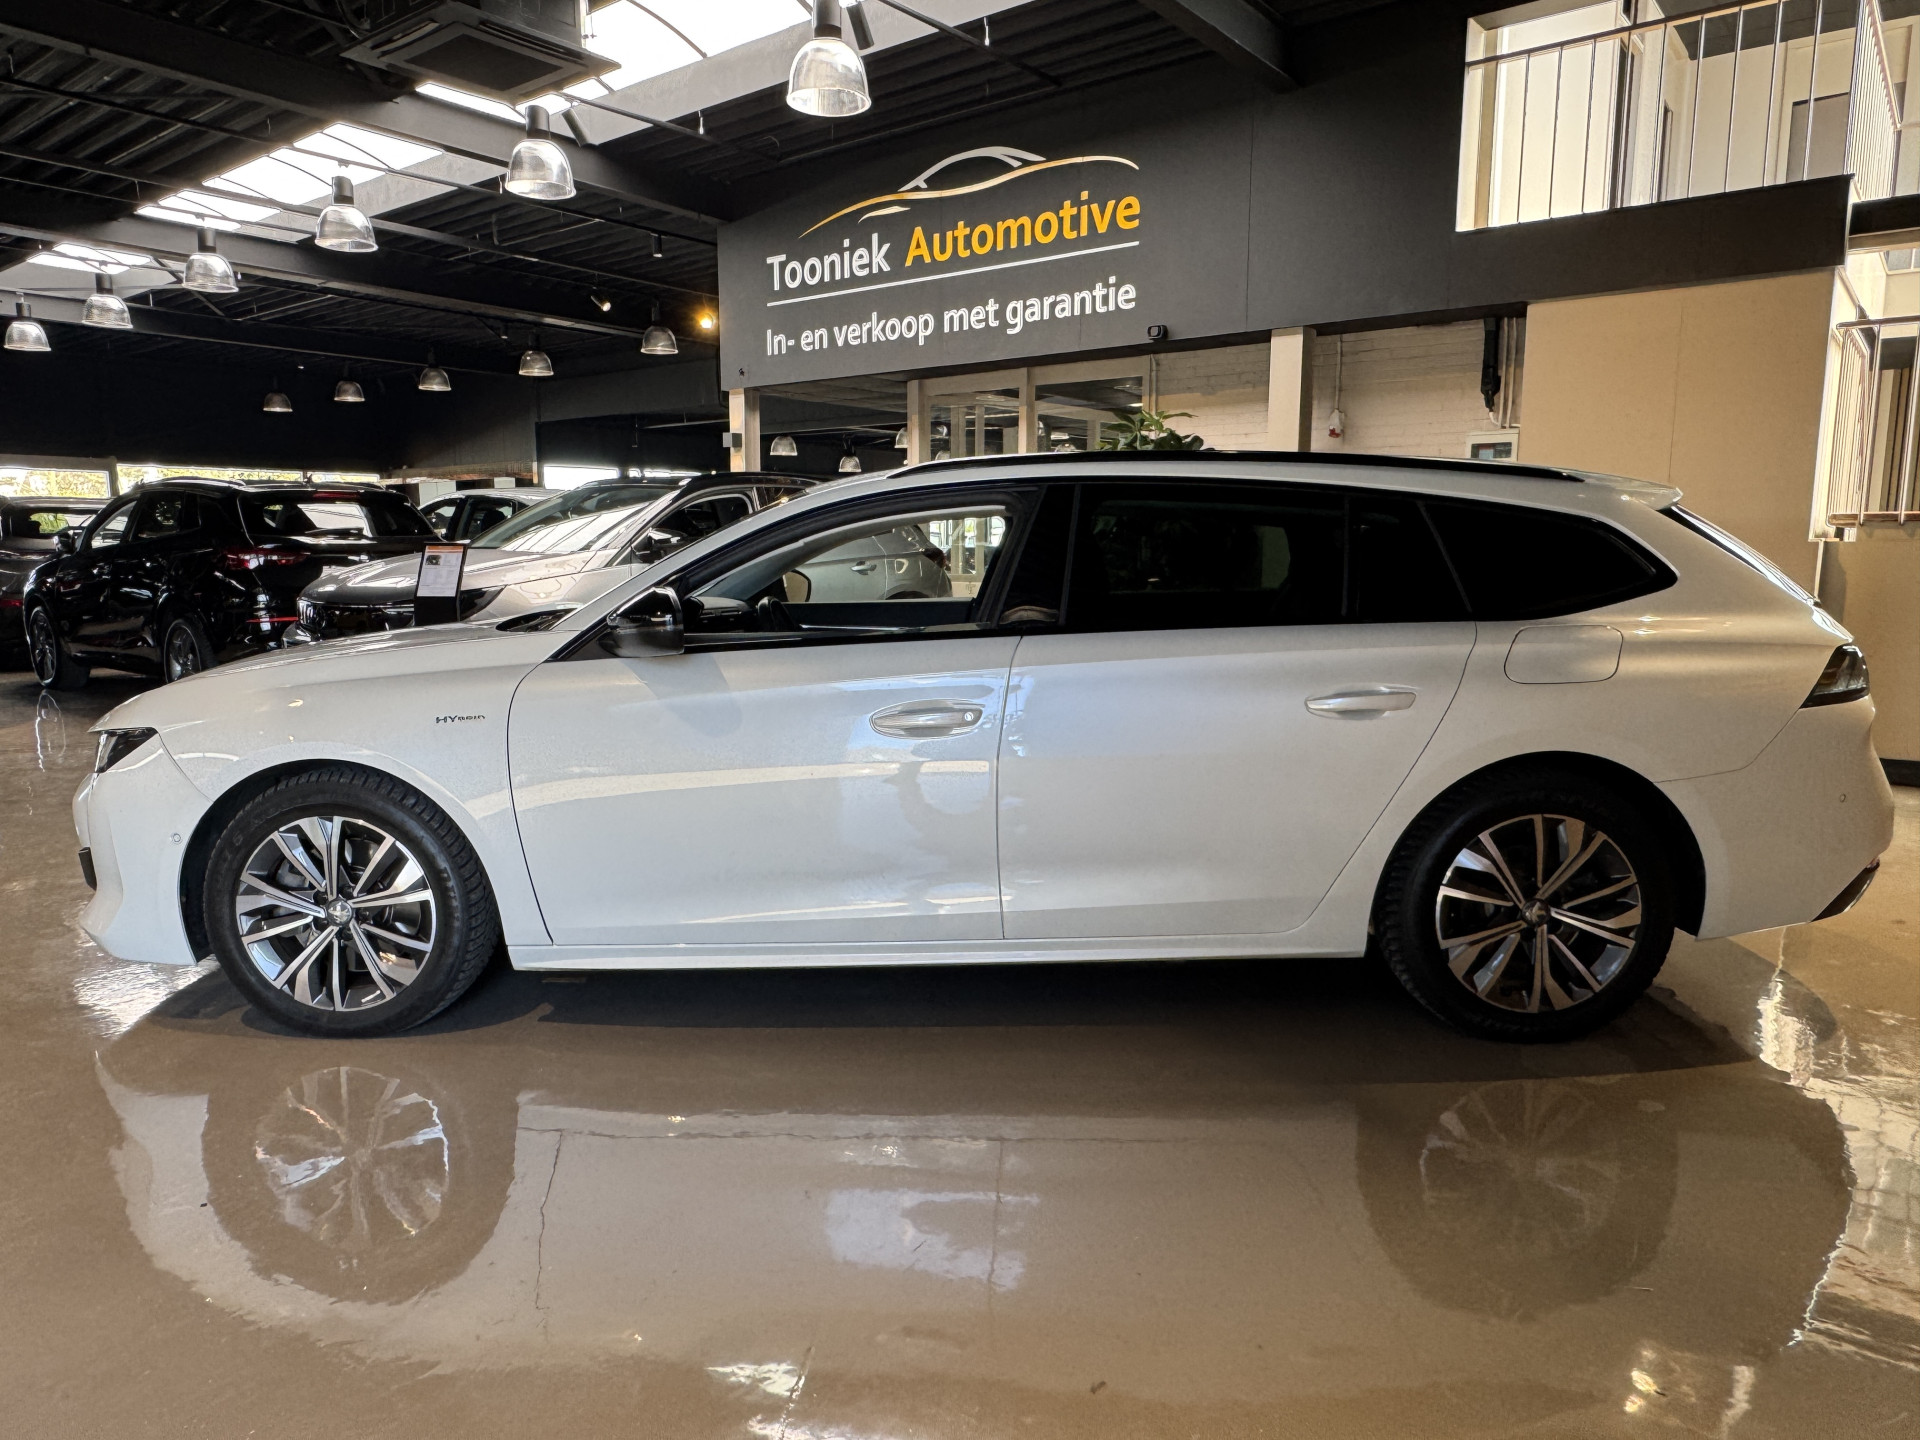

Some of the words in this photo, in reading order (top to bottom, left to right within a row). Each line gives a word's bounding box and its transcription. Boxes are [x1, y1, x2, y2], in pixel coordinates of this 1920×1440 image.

[766, 232, 891, 291] Tooniek
[904, 190, 1141, 268] Automotive
[766, 328, 796, 357] In-
[800, 327, 829, 352] en
[832, 311, 935, 347] verkoop
[943, 298, 1000, 334] met
[1005, 275, 1137, 336] garantie
